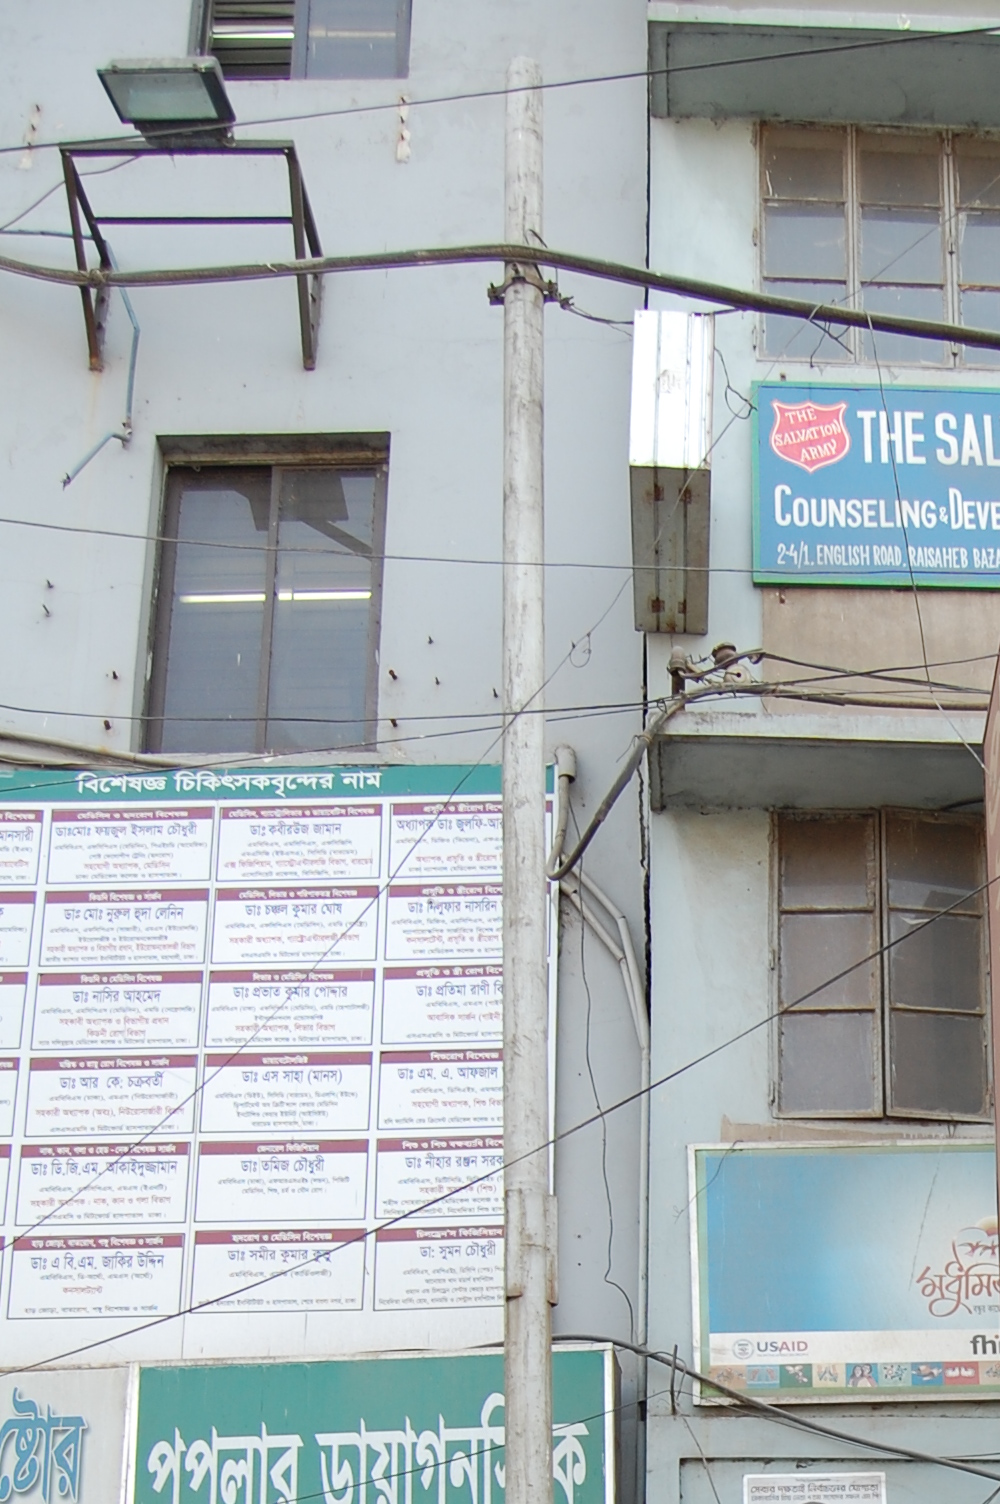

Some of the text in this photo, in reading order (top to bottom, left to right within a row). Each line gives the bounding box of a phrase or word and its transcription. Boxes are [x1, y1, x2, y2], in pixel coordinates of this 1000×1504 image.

[785, 408, 817, 424] THE
[775, 419, 841, 447] SALVATION
[857, 410, 926, 464] THE
[800, 439, 837, 462] ARMY
[817, 545, 870, 567] ENGLISH
[909, 548, 968, 568] RAISAHEB
[341, 771, 382, 789] নাম
[131, 822, 163, 836] ইসলাম
[250, 823, 342, 837] ডাঃ জামান
[438, 820, 452, 830] ডাঃ
[64, 909, 81, 921] ডাঃ
[84, 909, 103, 920] মোঃ
[155, 904, 184, 920] লেনিন
[245, 905, 261, 916] ডাঃ
[292, 903, 317, 918] কুমার
[408, 902, 424, 914] ডাঃ
[73, 987, 161, 1003] ডাঃ নাসির আহমেদ
[233, 987, 249, 1000] ডাঃ
[416, 985, 432, 997] ডাঃ
[436, 981, 466, 996] প্রতিমা
[242, 1071, 258, 1083] ডাঃ
[262, 1070, 279, 1083] এস
[283, 1069, 304, 1082] সাহা
[398, 1069, 414, 1080] ডাঃ
[457, 1066, 498, 1079] আফজাল
[60, 1078, 76, 1090] ডাঃ
[80, 1076, 99, 1088] আর
[31, 1163, 48, 1176] ডাঃ
[241, 1160, 258, 1173] ডাঃ
[293, 1155, 324, 1174] চৌধুরী
[405, 1157, 421, 1169] ডাঃ
[228, 1250, 245, 1262] ডাঃ
[280, 1249, 308, 1263] কুমার
[439, 1245, 462, 1261] সুমন
[465, 1240, 496, 1260] চৌধুরী
[30, 1257, 48, 1270] ডাঃ
[757, 1340, 808, 1353] USAID
